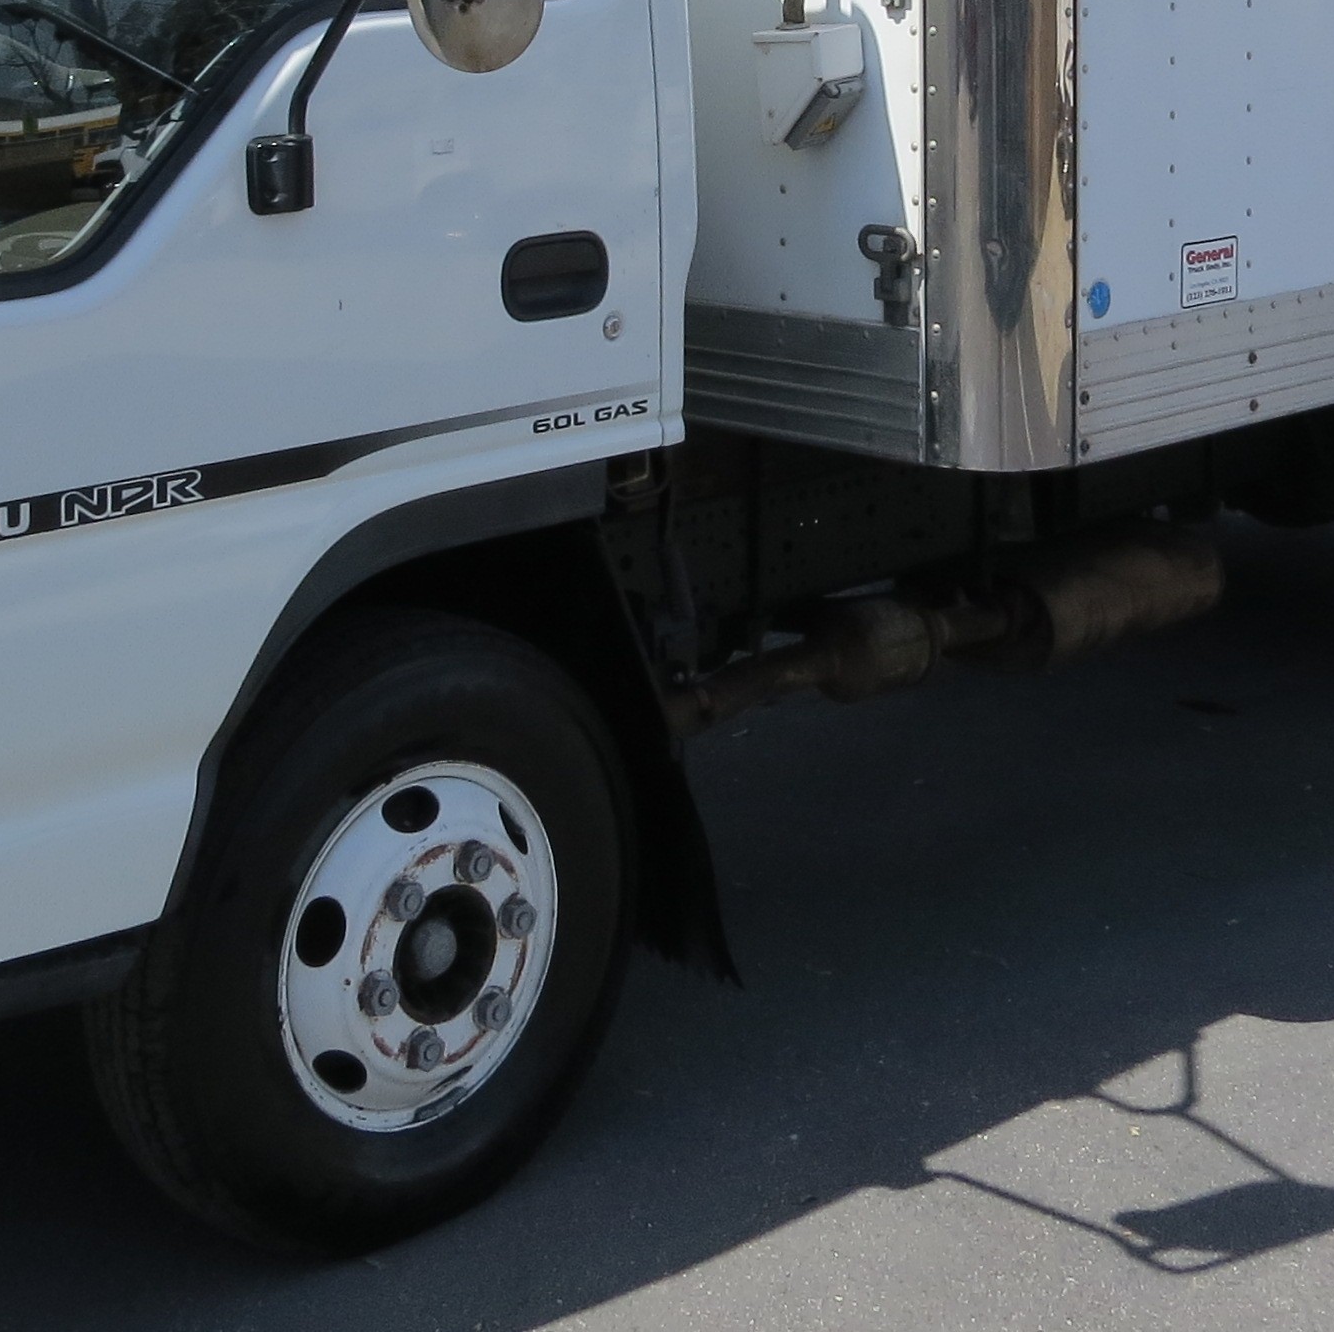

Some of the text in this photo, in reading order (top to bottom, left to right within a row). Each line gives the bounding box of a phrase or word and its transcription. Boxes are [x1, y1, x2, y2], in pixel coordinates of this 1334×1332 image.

[1186, 243, 1233, 265] General
[532, 399, 648, 434] 6.0L GAS
[60, 469, 205, 527] NPR
